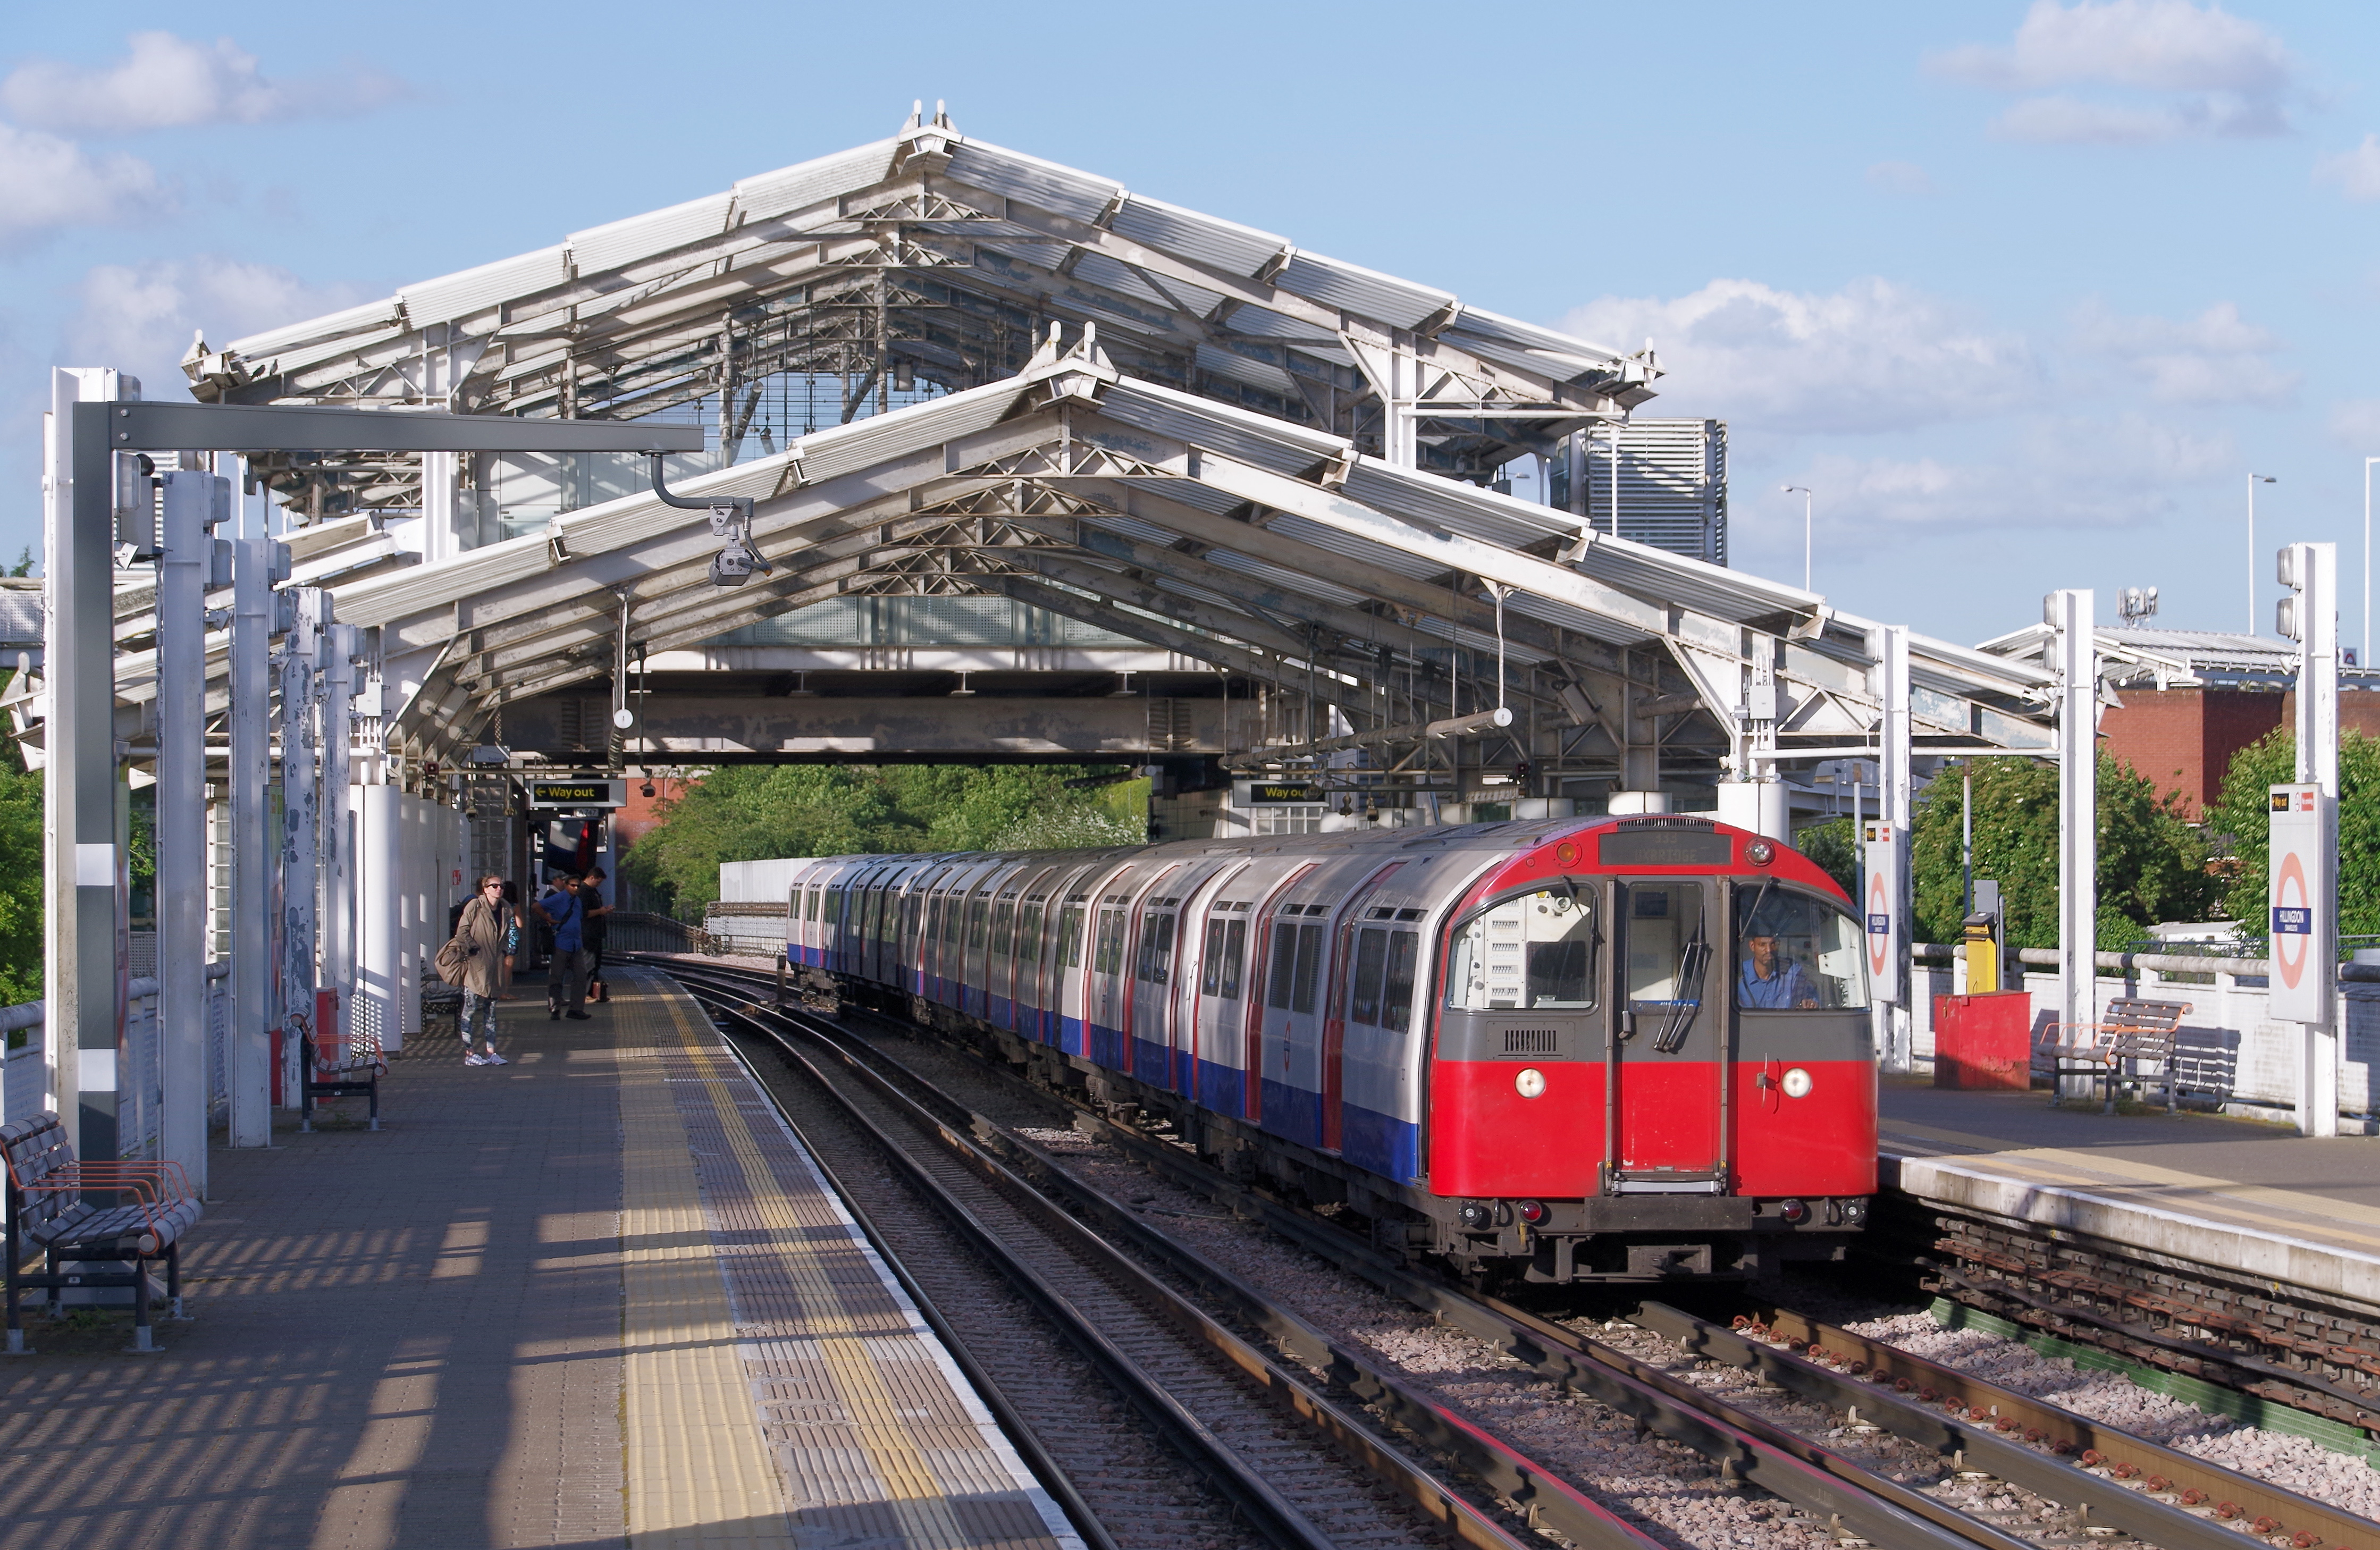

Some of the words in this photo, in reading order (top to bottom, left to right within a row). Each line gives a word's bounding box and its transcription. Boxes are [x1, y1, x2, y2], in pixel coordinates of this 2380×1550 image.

[549, 787, 572, 799] Way
[574, 788, 594, 797] out
[1265, 787, 1289, 799] Way
[1635, 848, 1697, 862] UXBRIDGE
[2279, 910, 2304, 923] HILLINGDON
